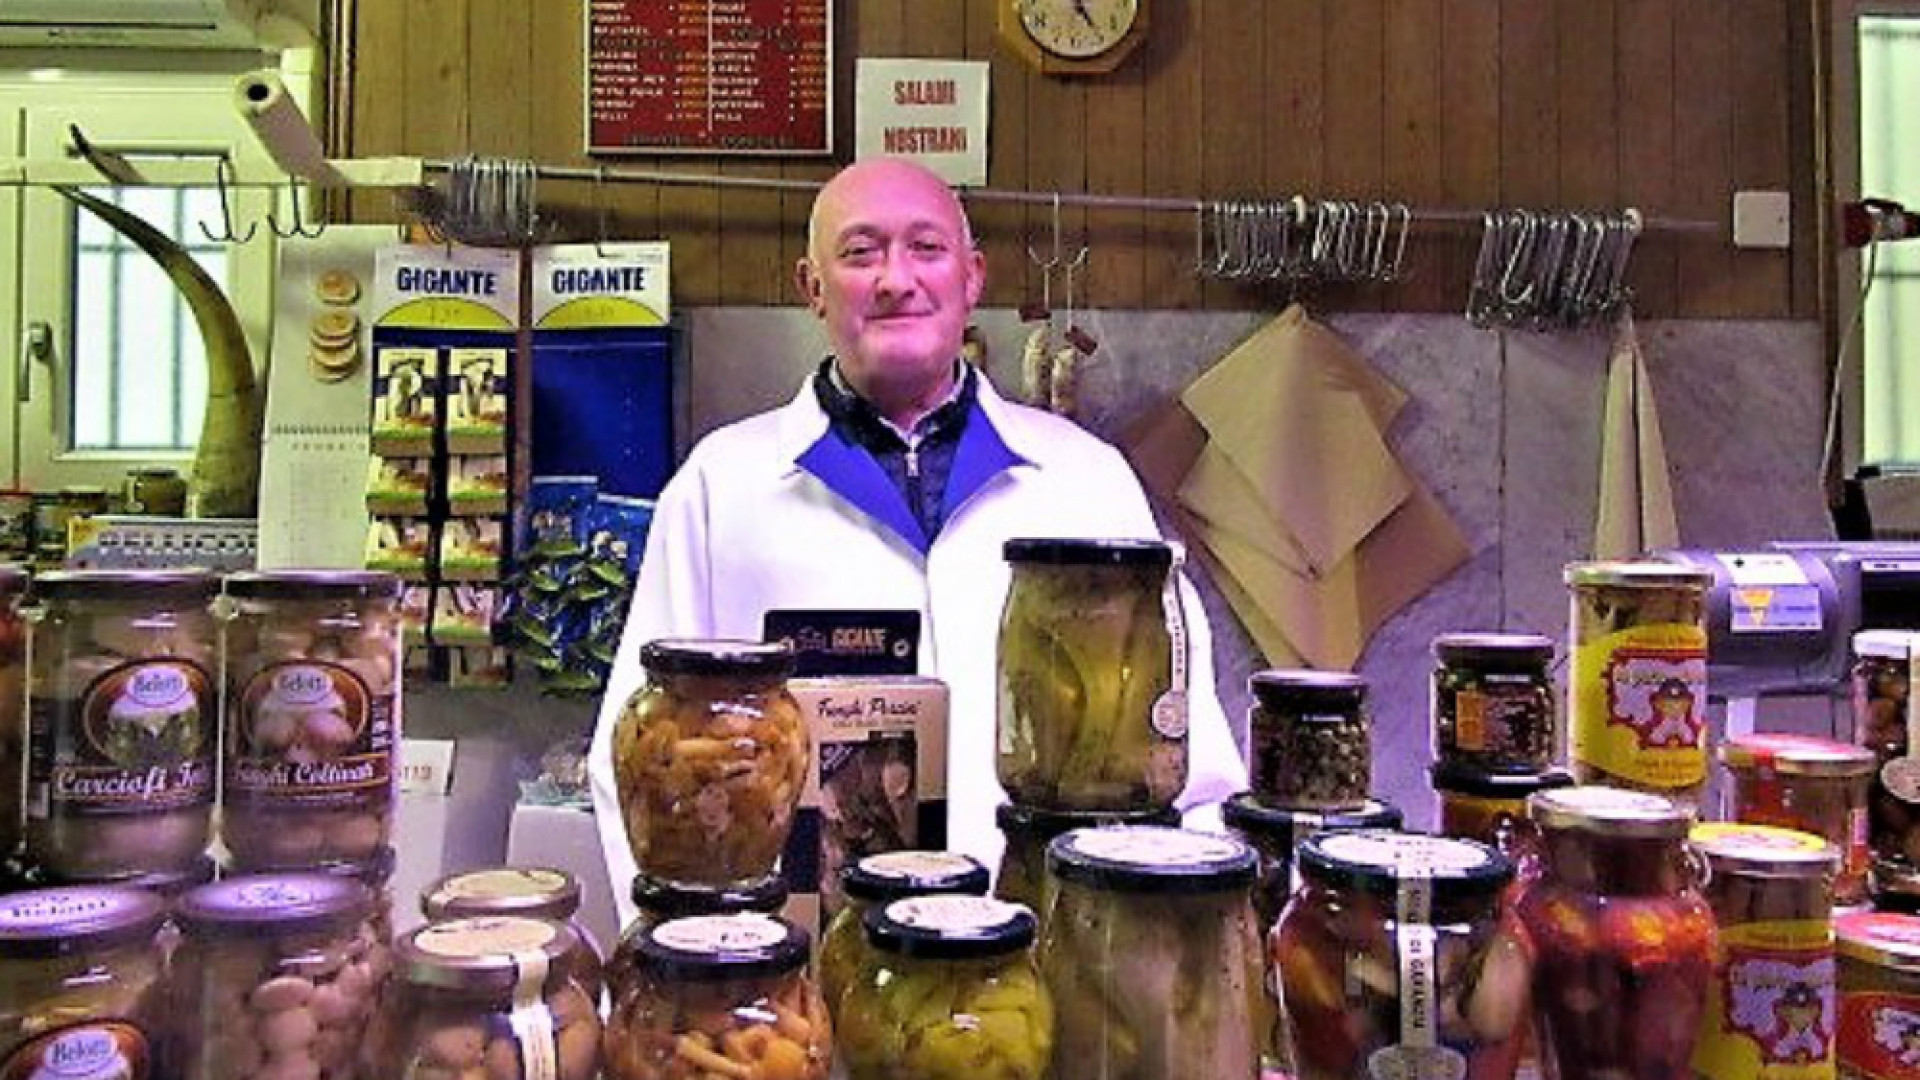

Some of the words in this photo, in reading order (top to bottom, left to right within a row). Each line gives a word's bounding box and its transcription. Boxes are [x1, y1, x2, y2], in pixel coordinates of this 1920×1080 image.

[894, 79, 955, 105] SALAMI
[884, 126, 967, 154] NOSTRANI
[397, 267, 496, 294] GIGANTE
[552, 267, 645, 294] GIGANTE
[57, 765, 167, 800] Carciofi
